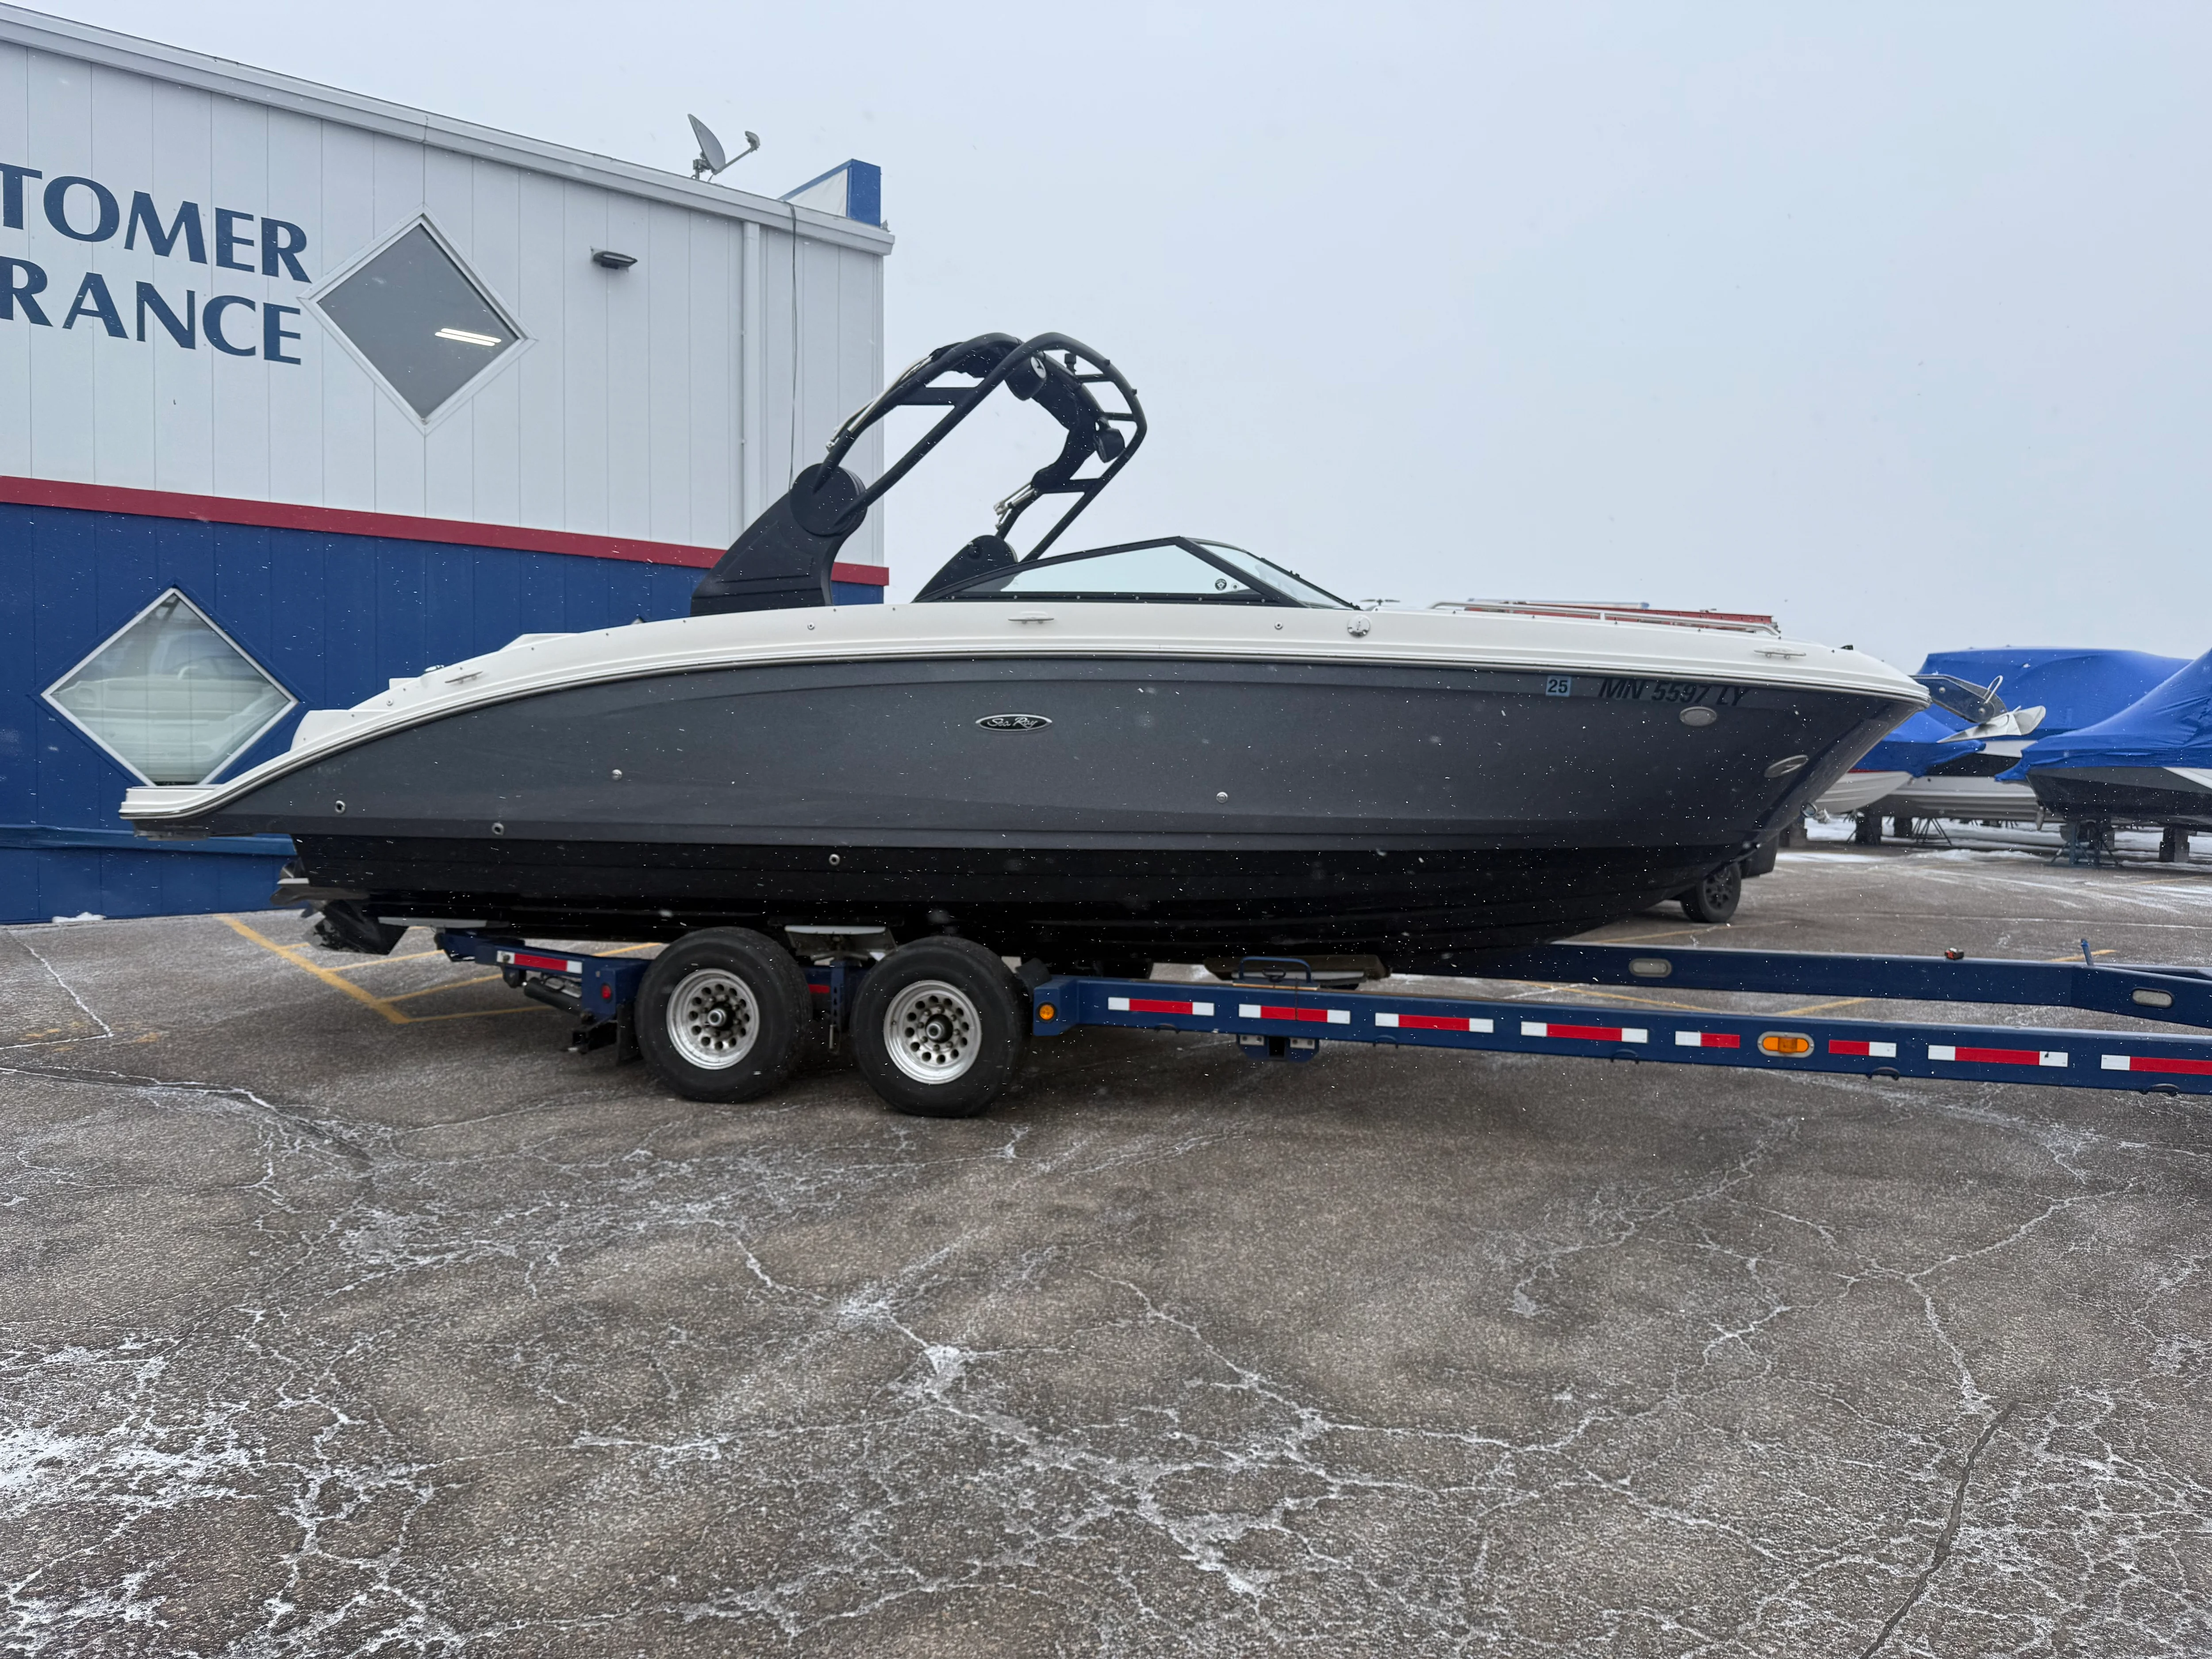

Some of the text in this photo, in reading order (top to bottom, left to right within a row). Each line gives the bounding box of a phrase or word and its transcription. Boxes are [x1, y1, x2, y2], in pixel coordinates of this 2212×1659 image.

[0, 163, 312, 284] TOMER
[0, 256, 301, 365] RANCE
[1547, 679, 1568, 693] 25
[1597, 677, 1751, 706] MN 5597 LY
[987, 717, 1038, 730] Sea Ray
